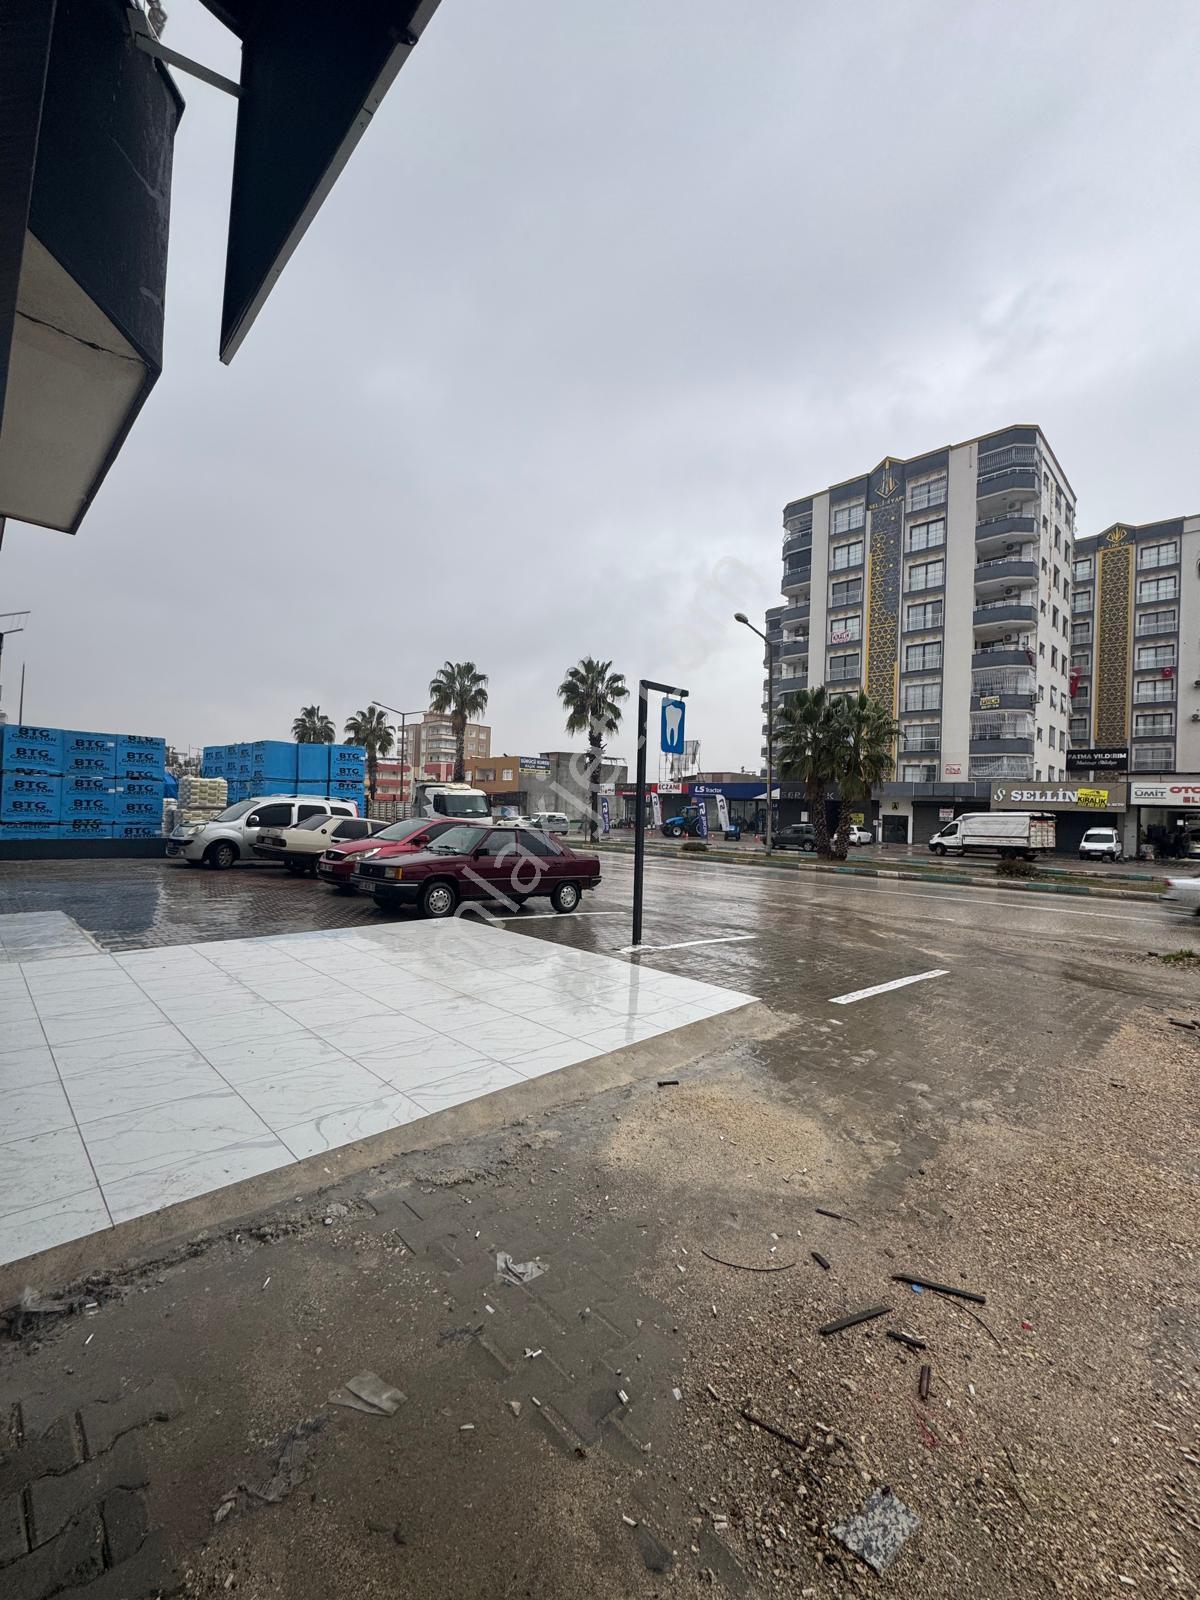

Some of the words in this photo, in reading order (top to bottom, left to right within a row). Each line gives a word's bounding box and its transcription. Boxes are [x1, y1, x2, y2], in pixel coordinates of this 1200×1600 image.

[18, 727, 50, 738] BTG
[75, 739, 105, 747] BTG
[16, 747, 49, 757] BTG
[127, 752, 154, 760] BTG
[74, 759, 104, 767] BTG
[339, 767, 360, 775] BTG
[14, 780, 48, 789] BTG
[74, 779, 103, 787] BTG
[658, 783, 681, 791] ECZANE
[127, 784, 154, 792] BTG
[695, 785, 705, 793] LS
[12, 801, 47, 810] BTG
[73, 799, 103, 807] BTG
[126, 803, 153, 811] BTG
[124, 827, 151, 835] BTG
